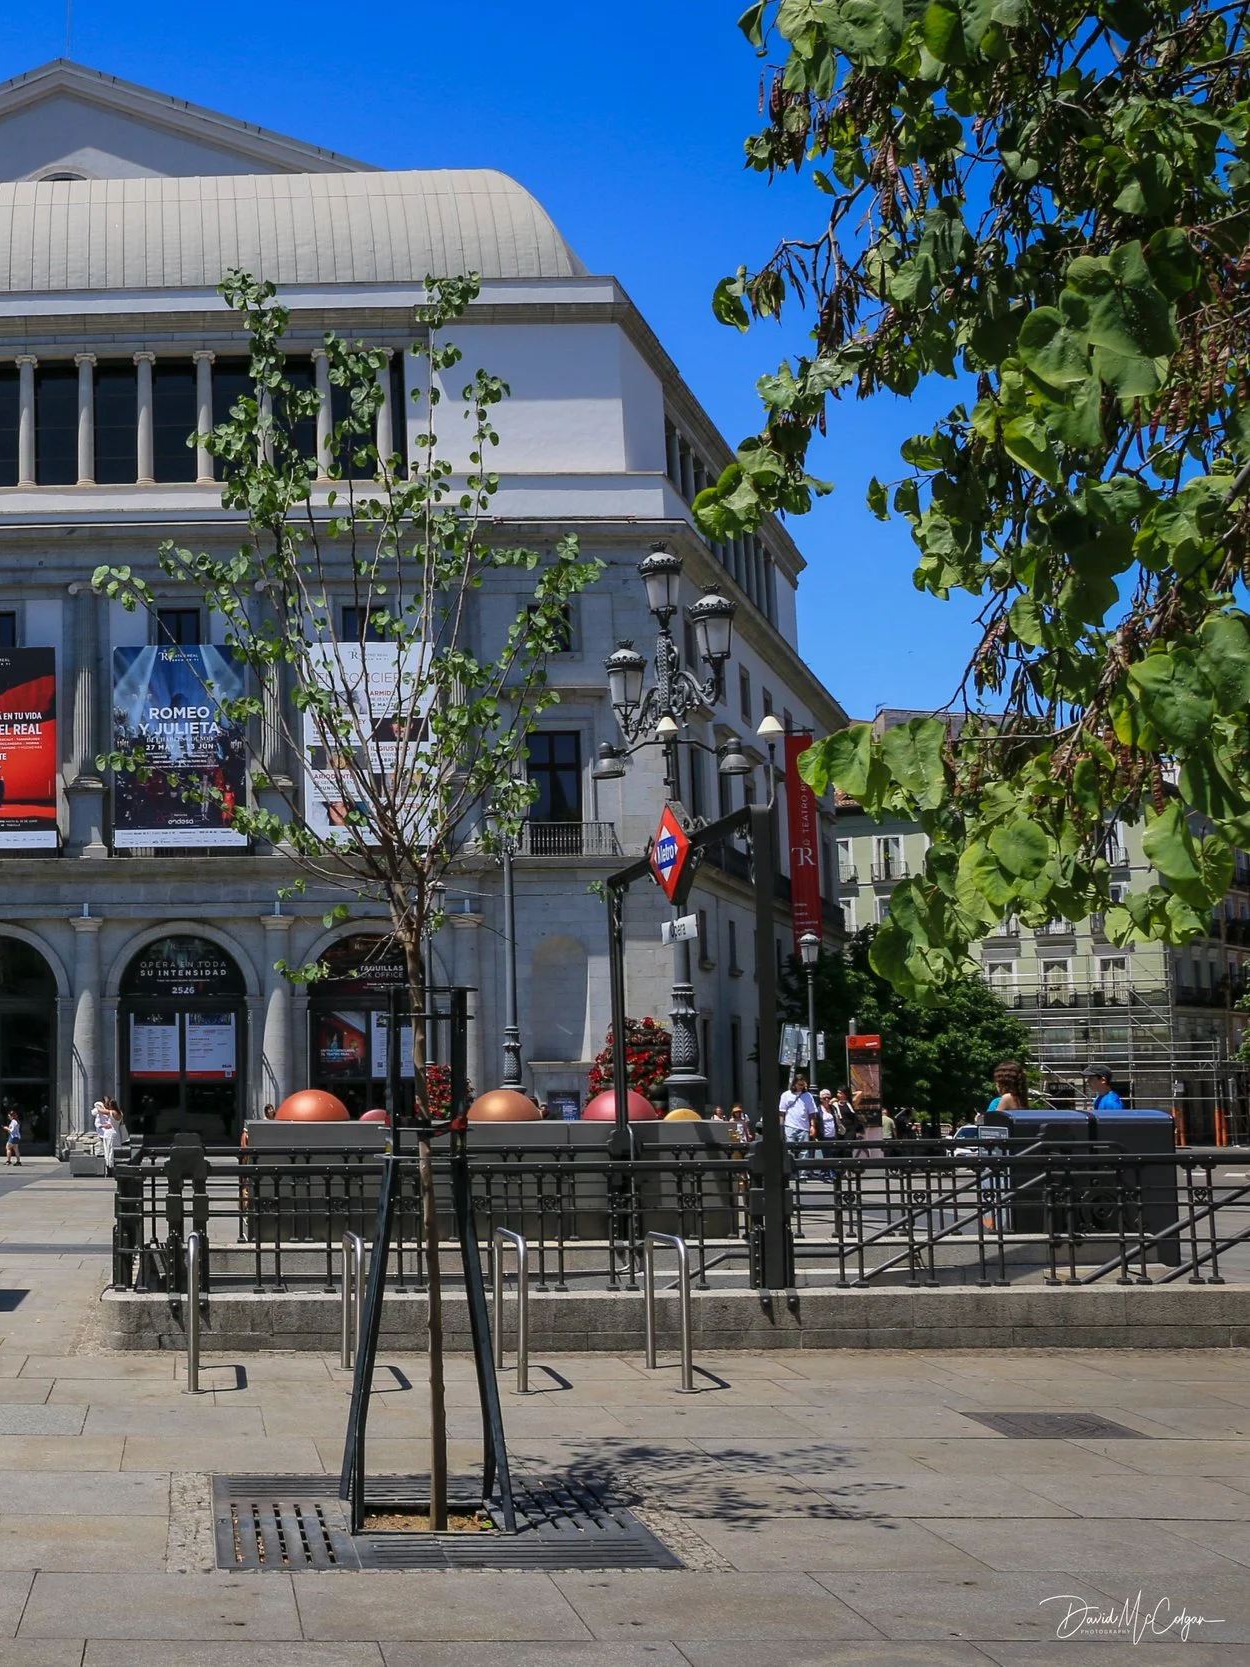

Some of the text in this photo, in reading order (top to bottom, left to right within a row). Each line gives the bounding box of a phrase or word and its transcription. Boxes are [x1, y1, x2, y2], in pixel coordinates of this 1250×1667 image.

[3, 712, 13, 720] EN
[14, 712, 23, 720] TU
[25, 712, 42, 720] VIDA
[149, 706, 210, 720] ROMEO
[13, 723, 43, 735] REAL
[138, 721, 221, 735] Y JULIETA
[800, 794, 811, 834] TEATRO
[657, 844, 675, 864] Metro
[197, 960, 227, 968] TODA
